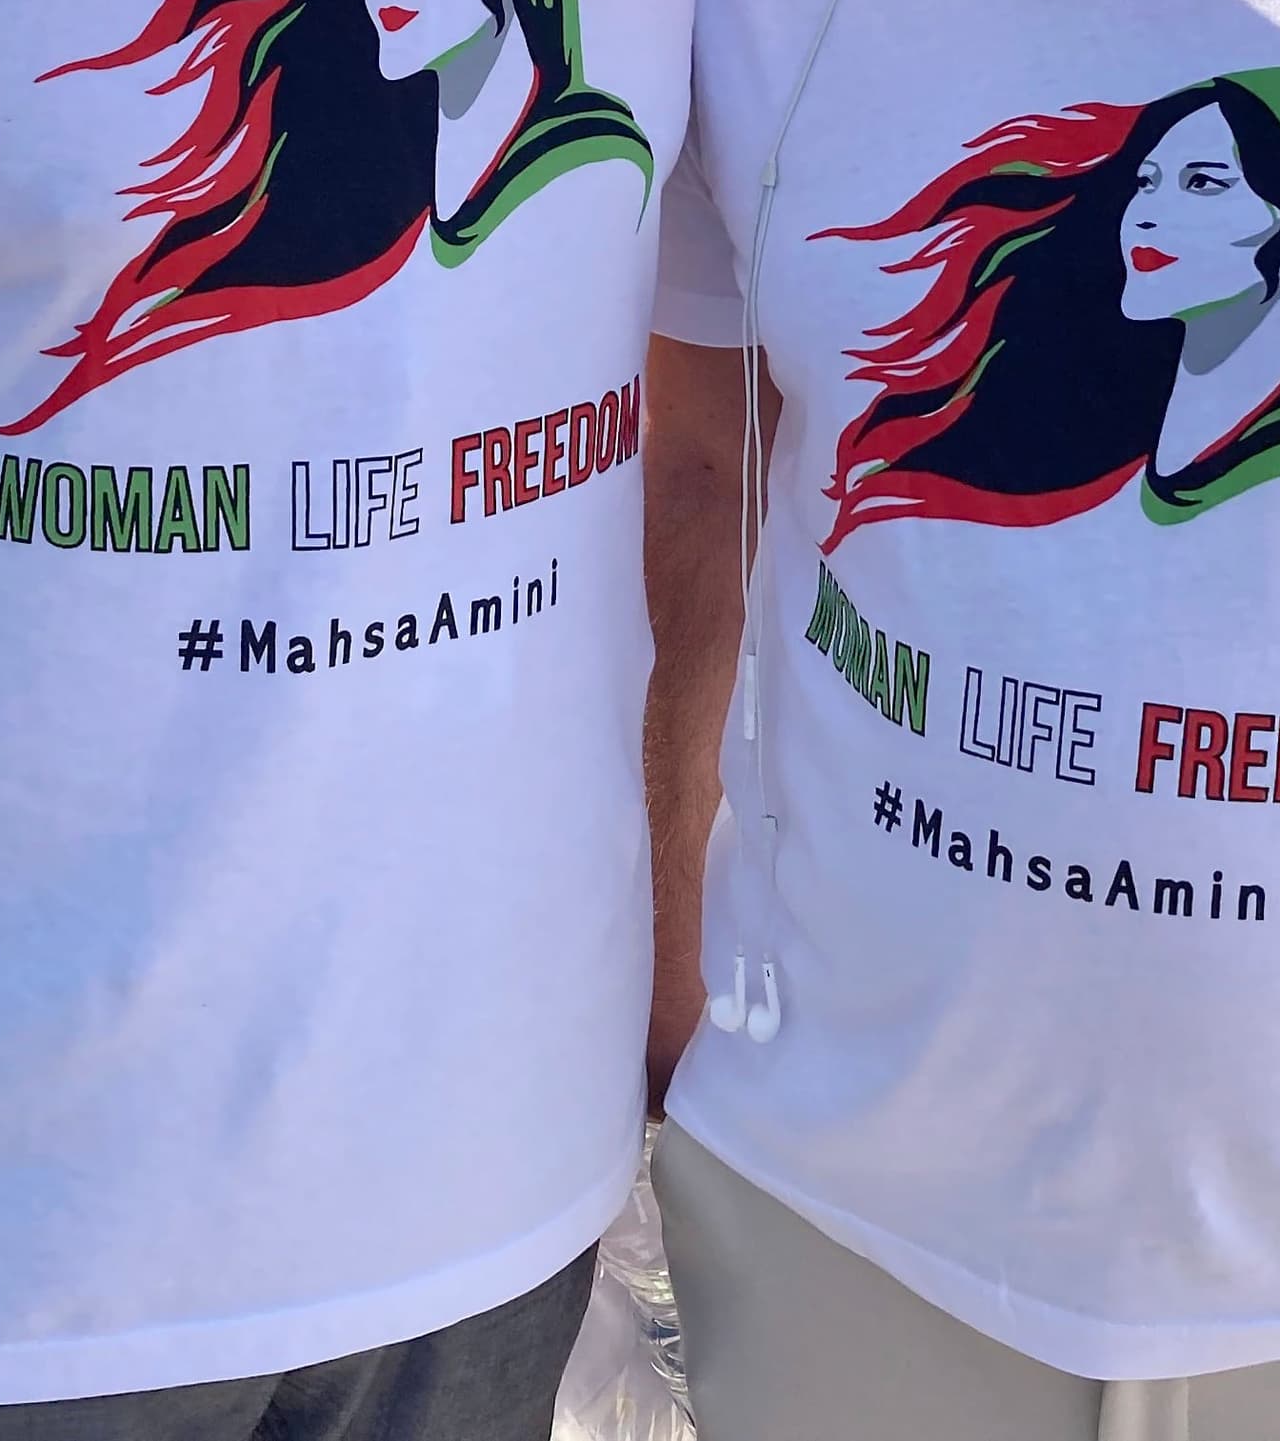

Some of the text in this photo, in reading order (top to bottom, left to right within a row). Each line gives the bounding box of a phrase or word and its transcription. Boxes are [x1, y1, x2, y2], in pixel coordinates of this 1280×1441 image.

[291, 447, 423, 551] LIFE
[450, 374, 640, 524] FREEDOM
[178, 558, 559, 674] #MahsaAmini
[805, 560, 930, 736] WOMAN
[960, 666, 1102, 786] LIFE
